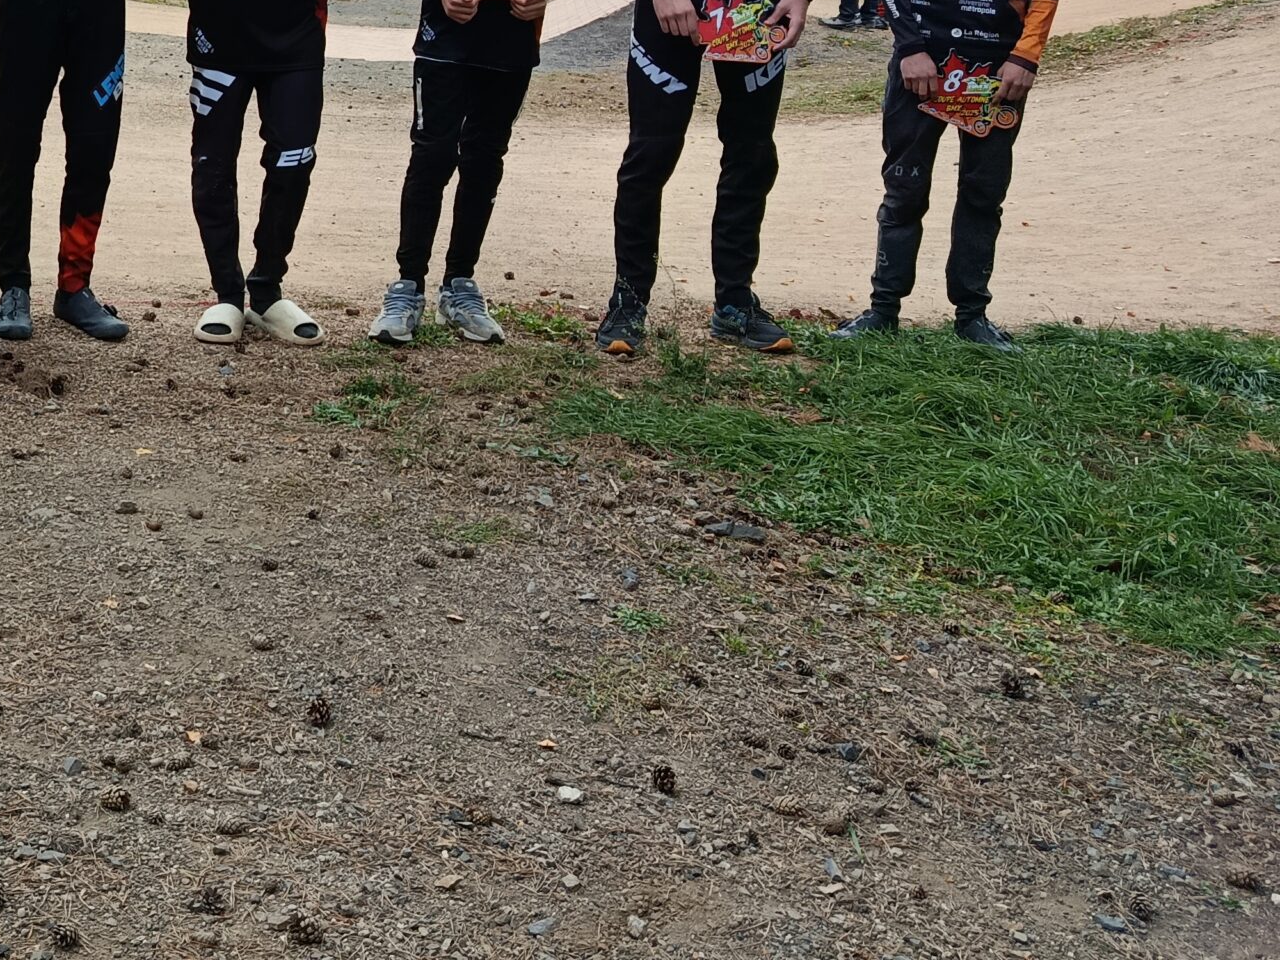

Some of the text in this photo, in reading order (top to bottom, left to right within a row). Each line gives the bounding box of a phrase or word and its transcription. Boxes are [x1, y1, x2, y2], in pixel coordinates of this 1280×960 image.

[960, 5, 996, 14] métropole
[974, 30, 1000, 38] Région
[711, 33, 730, 47] COUPE
[943, 69, 964, 92] 8
[957, 95, 990, 104] AUTOMNE
